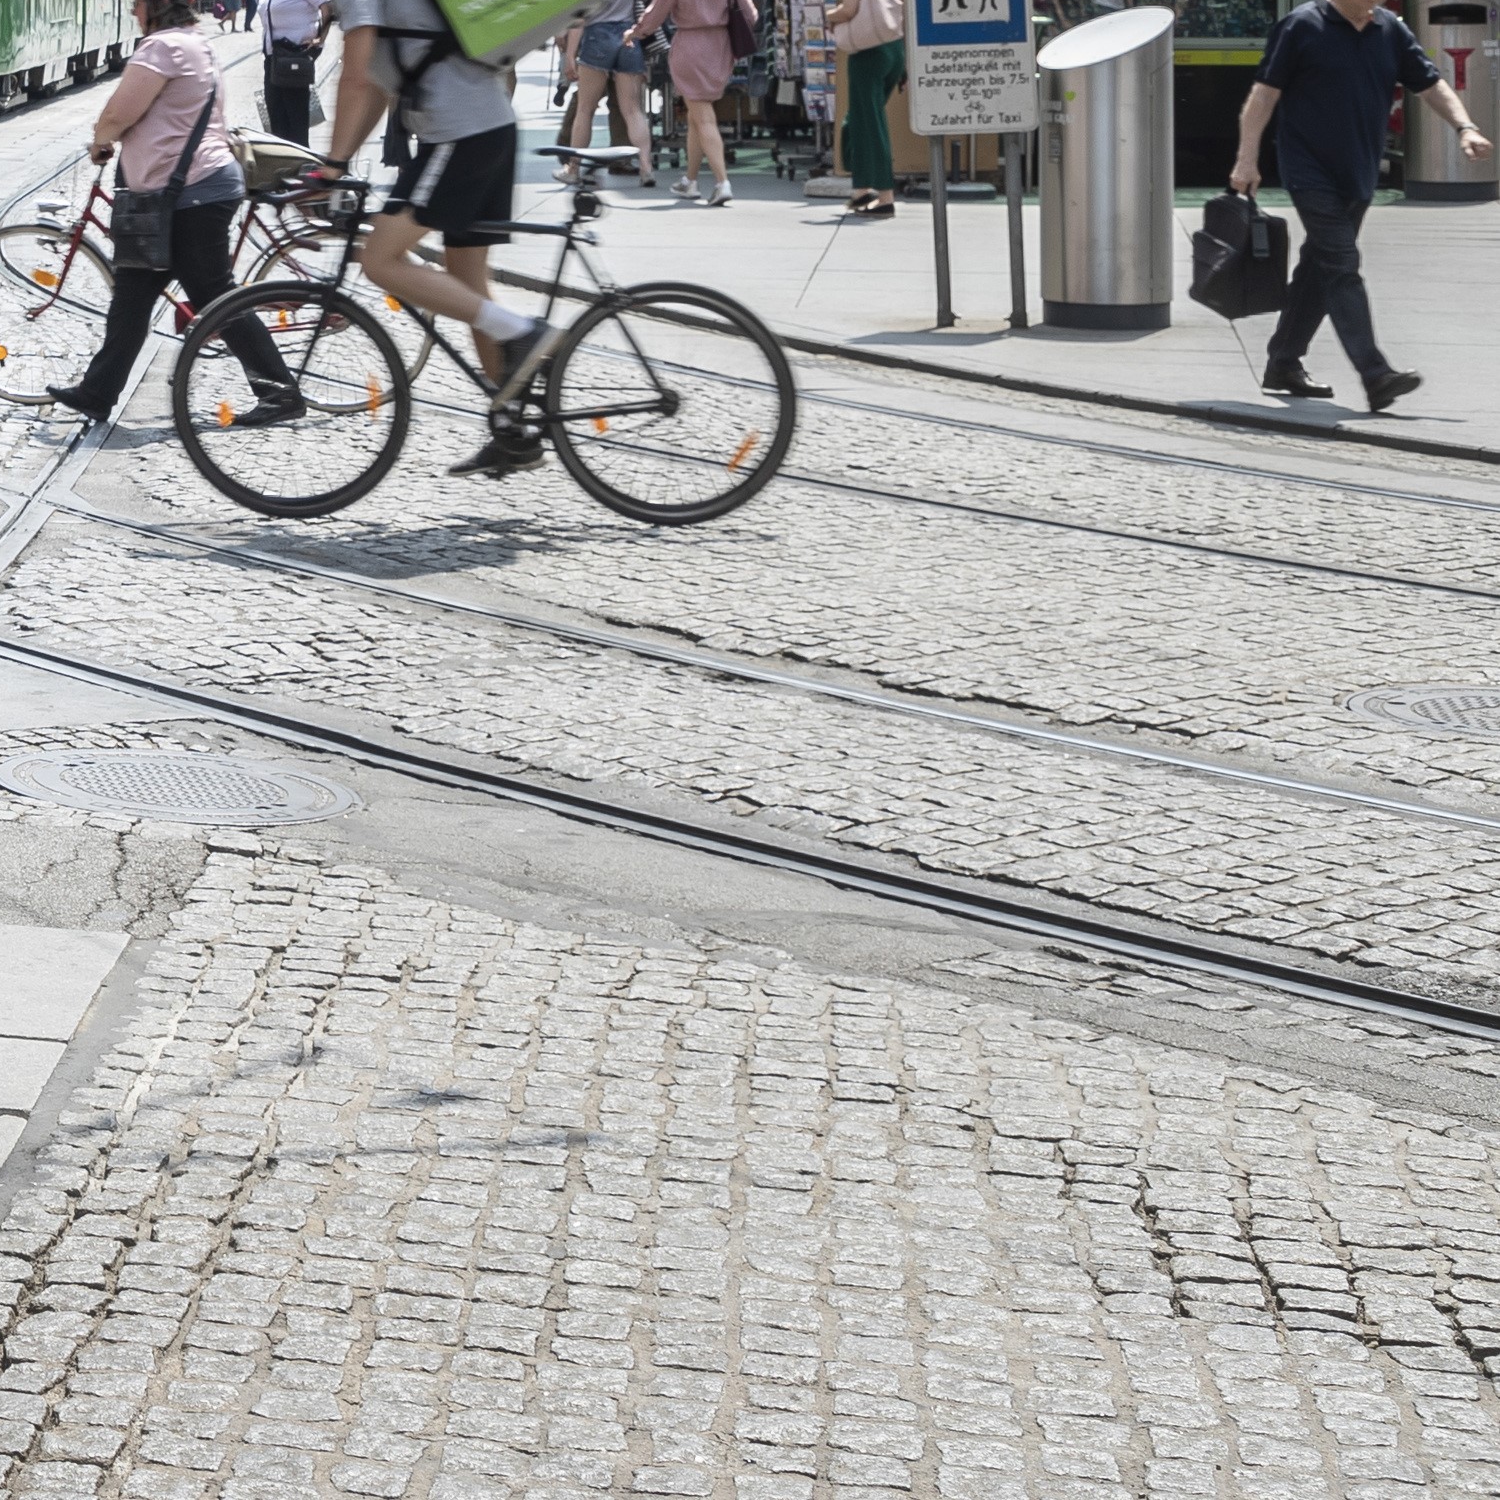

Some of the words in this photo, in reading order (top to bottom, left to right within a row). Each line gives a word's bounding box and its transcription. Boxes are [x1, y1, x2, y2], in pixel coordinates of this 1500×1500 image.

[931, 49, 1015, 62] ausgenommen
[925, 62, 999, 75] Ladetätigkeit
[1002, 61, 1021, 71] mit
[918, 75, 985, 88] Fahrzeugen
[989, 74, 1006, 86] bis
[930, 113, 972, 126] Zufahrt
[977, 112, 994, 124] für
[998, 112, 1022, 124] Taxi
